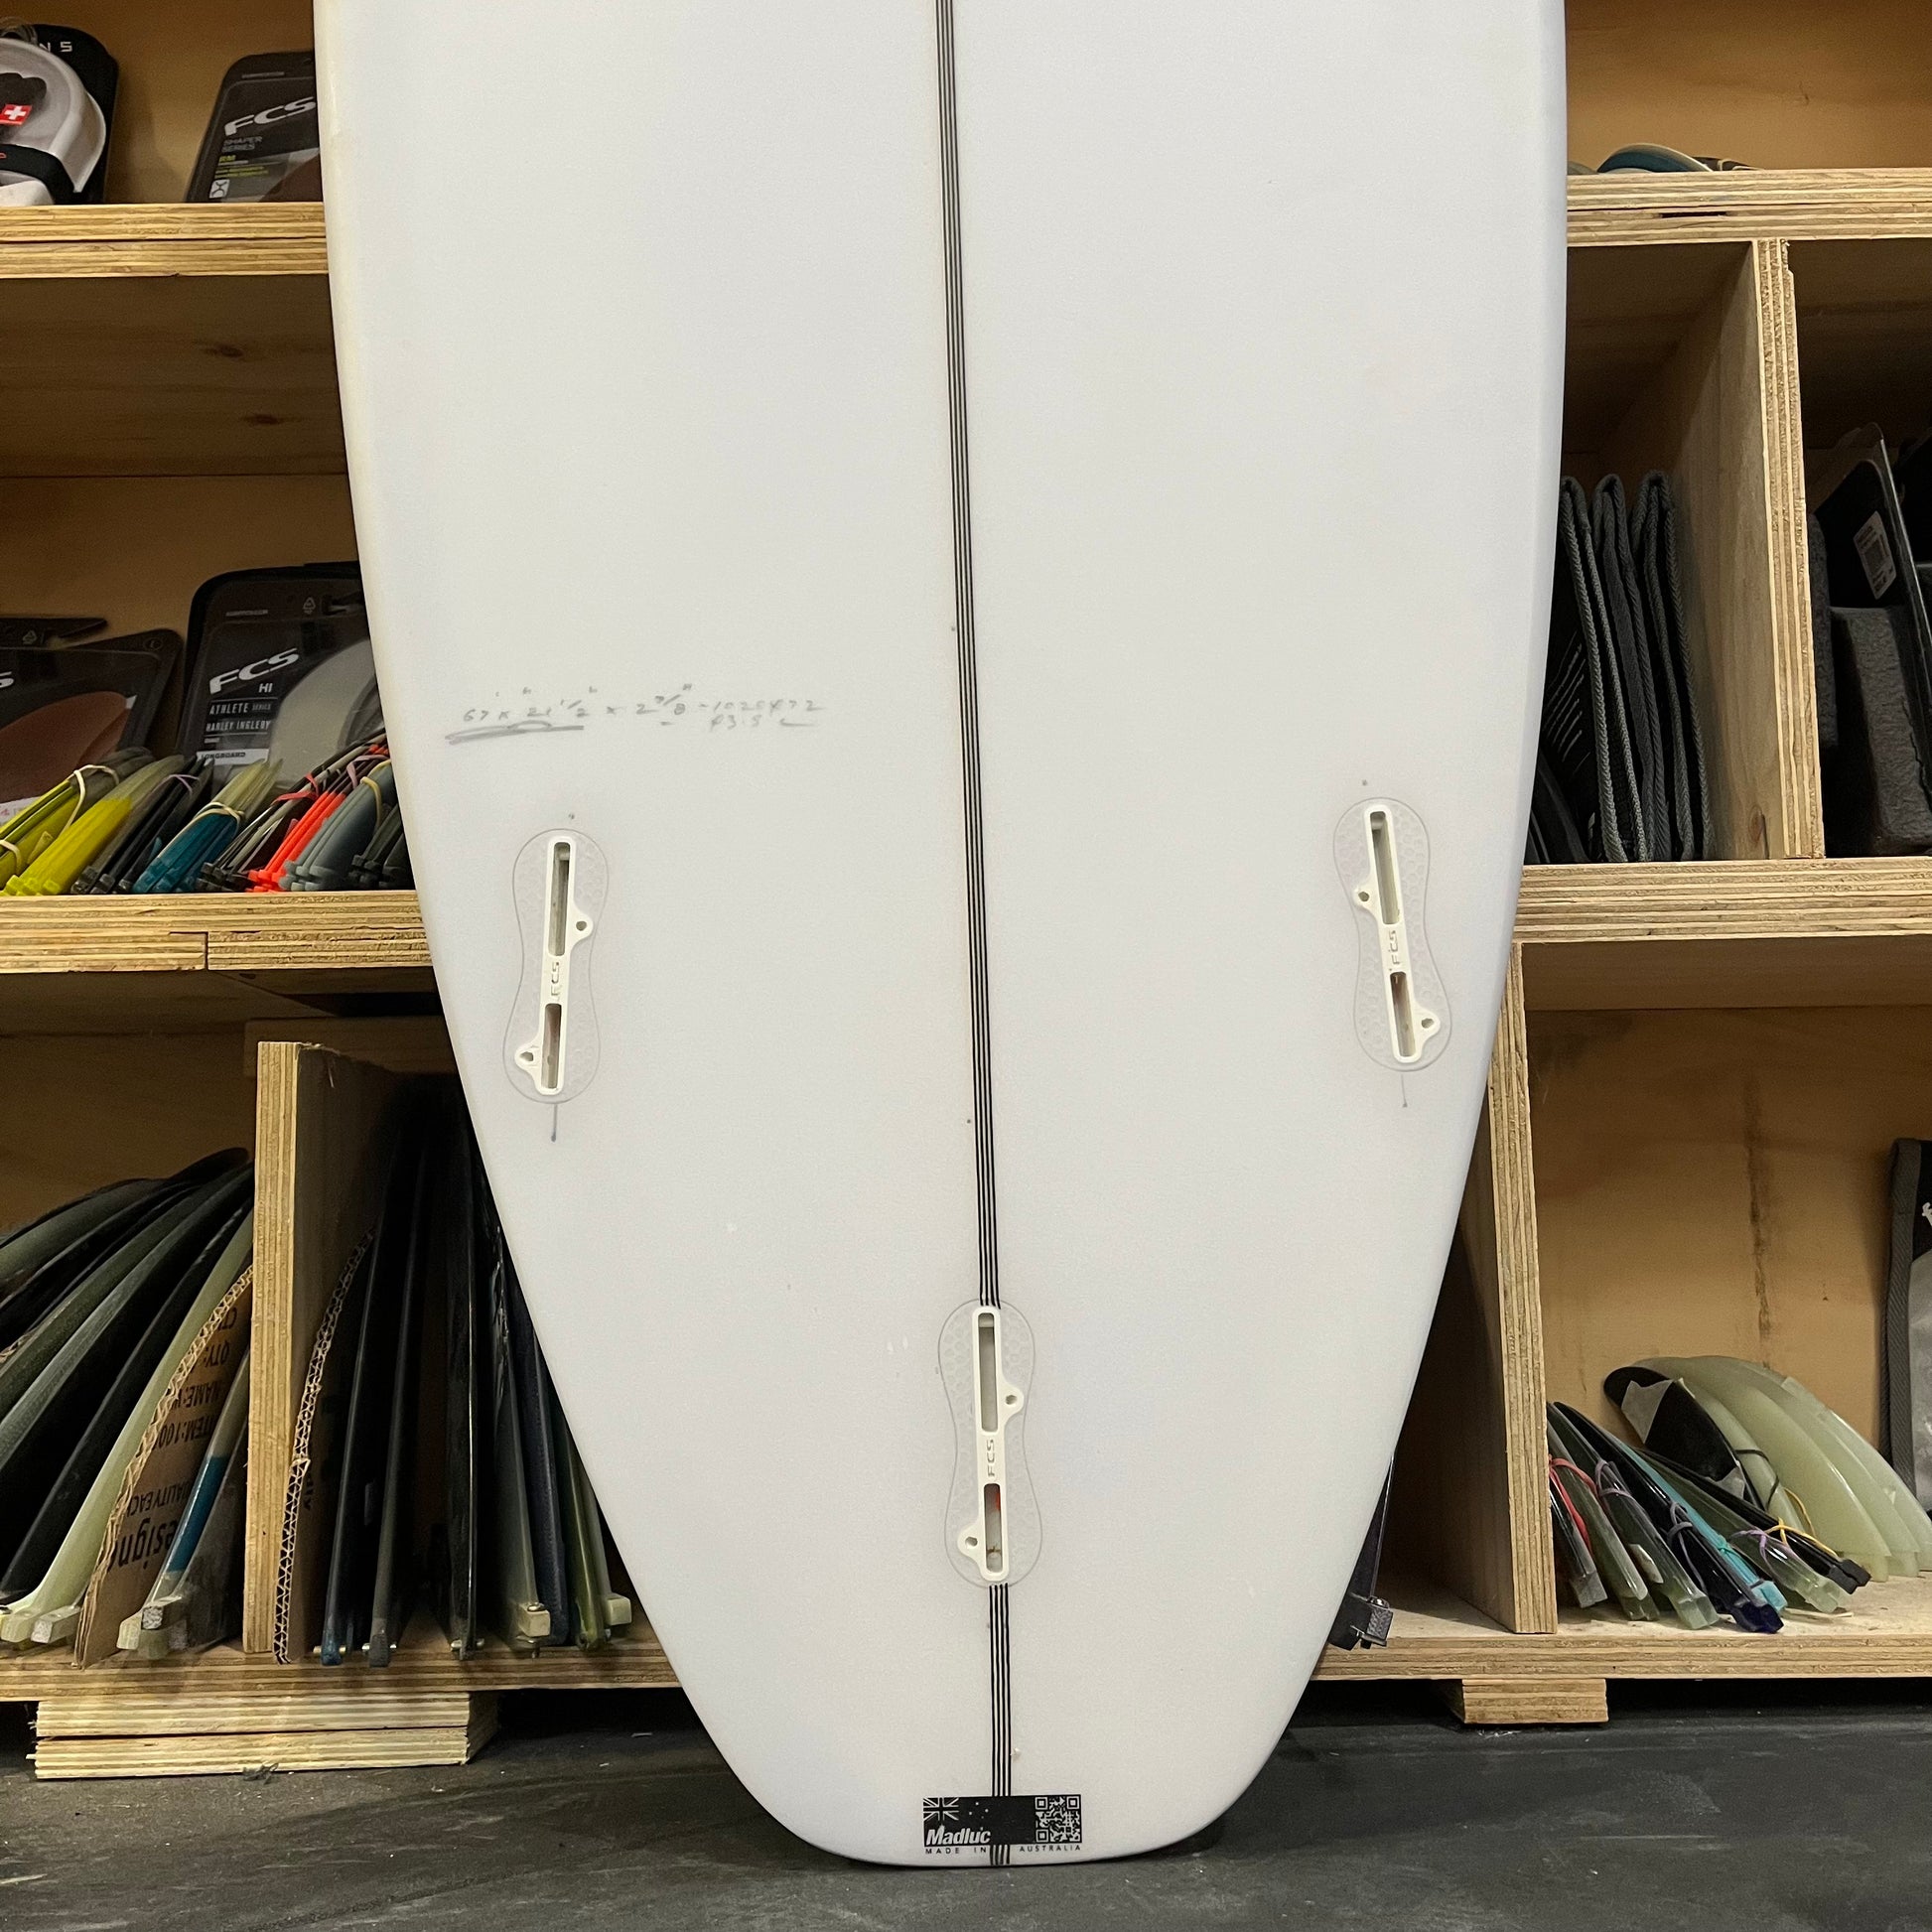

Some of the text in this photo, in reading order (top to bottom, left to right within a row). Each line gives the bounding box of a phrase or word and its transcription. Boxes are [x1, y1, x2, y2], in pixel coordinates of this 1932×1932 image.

[224, 96, 317, 136] FCS
[209, 647, 299, 695] FCS
[259, 683, 273, 693] HI
[209, 702, 249, 716] ATHLETE
[987, 1439, 996, 1477] FCS
[925, 1825, 991, 1846] Madluc
